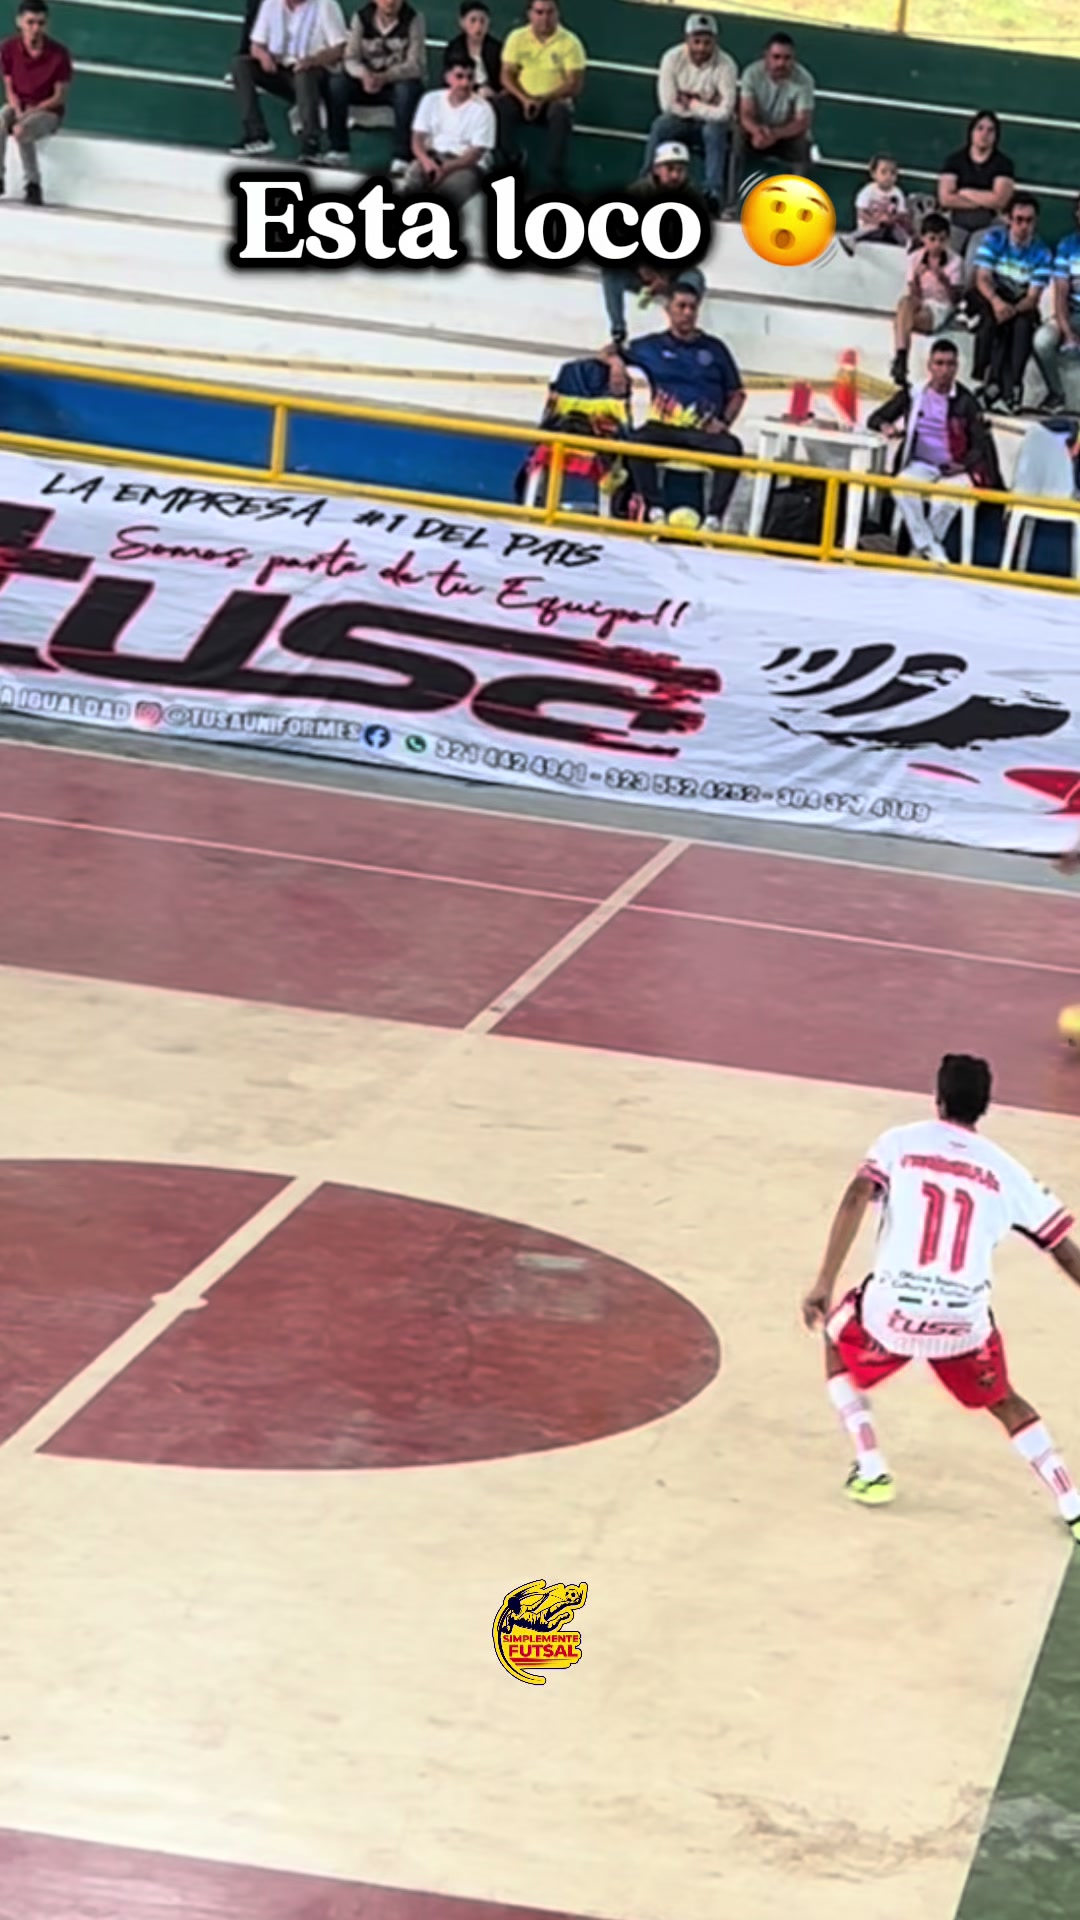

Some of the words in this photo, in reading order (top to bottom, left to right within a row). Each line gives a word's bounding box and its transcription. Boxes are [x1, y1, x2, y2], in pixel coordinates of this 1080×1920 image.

[41, 472, 104, 503] LA
[112, 483, 328, 526] EMPRESA
[353, 509, 407, 532] #1
[412, 518, 489, 550] DEL
[110, 525, 253, 568] Somos
[427, 560, 485, 596] tu
[653, 774, 699, 798] 552
[918, 1181, 974, 1272] 11
